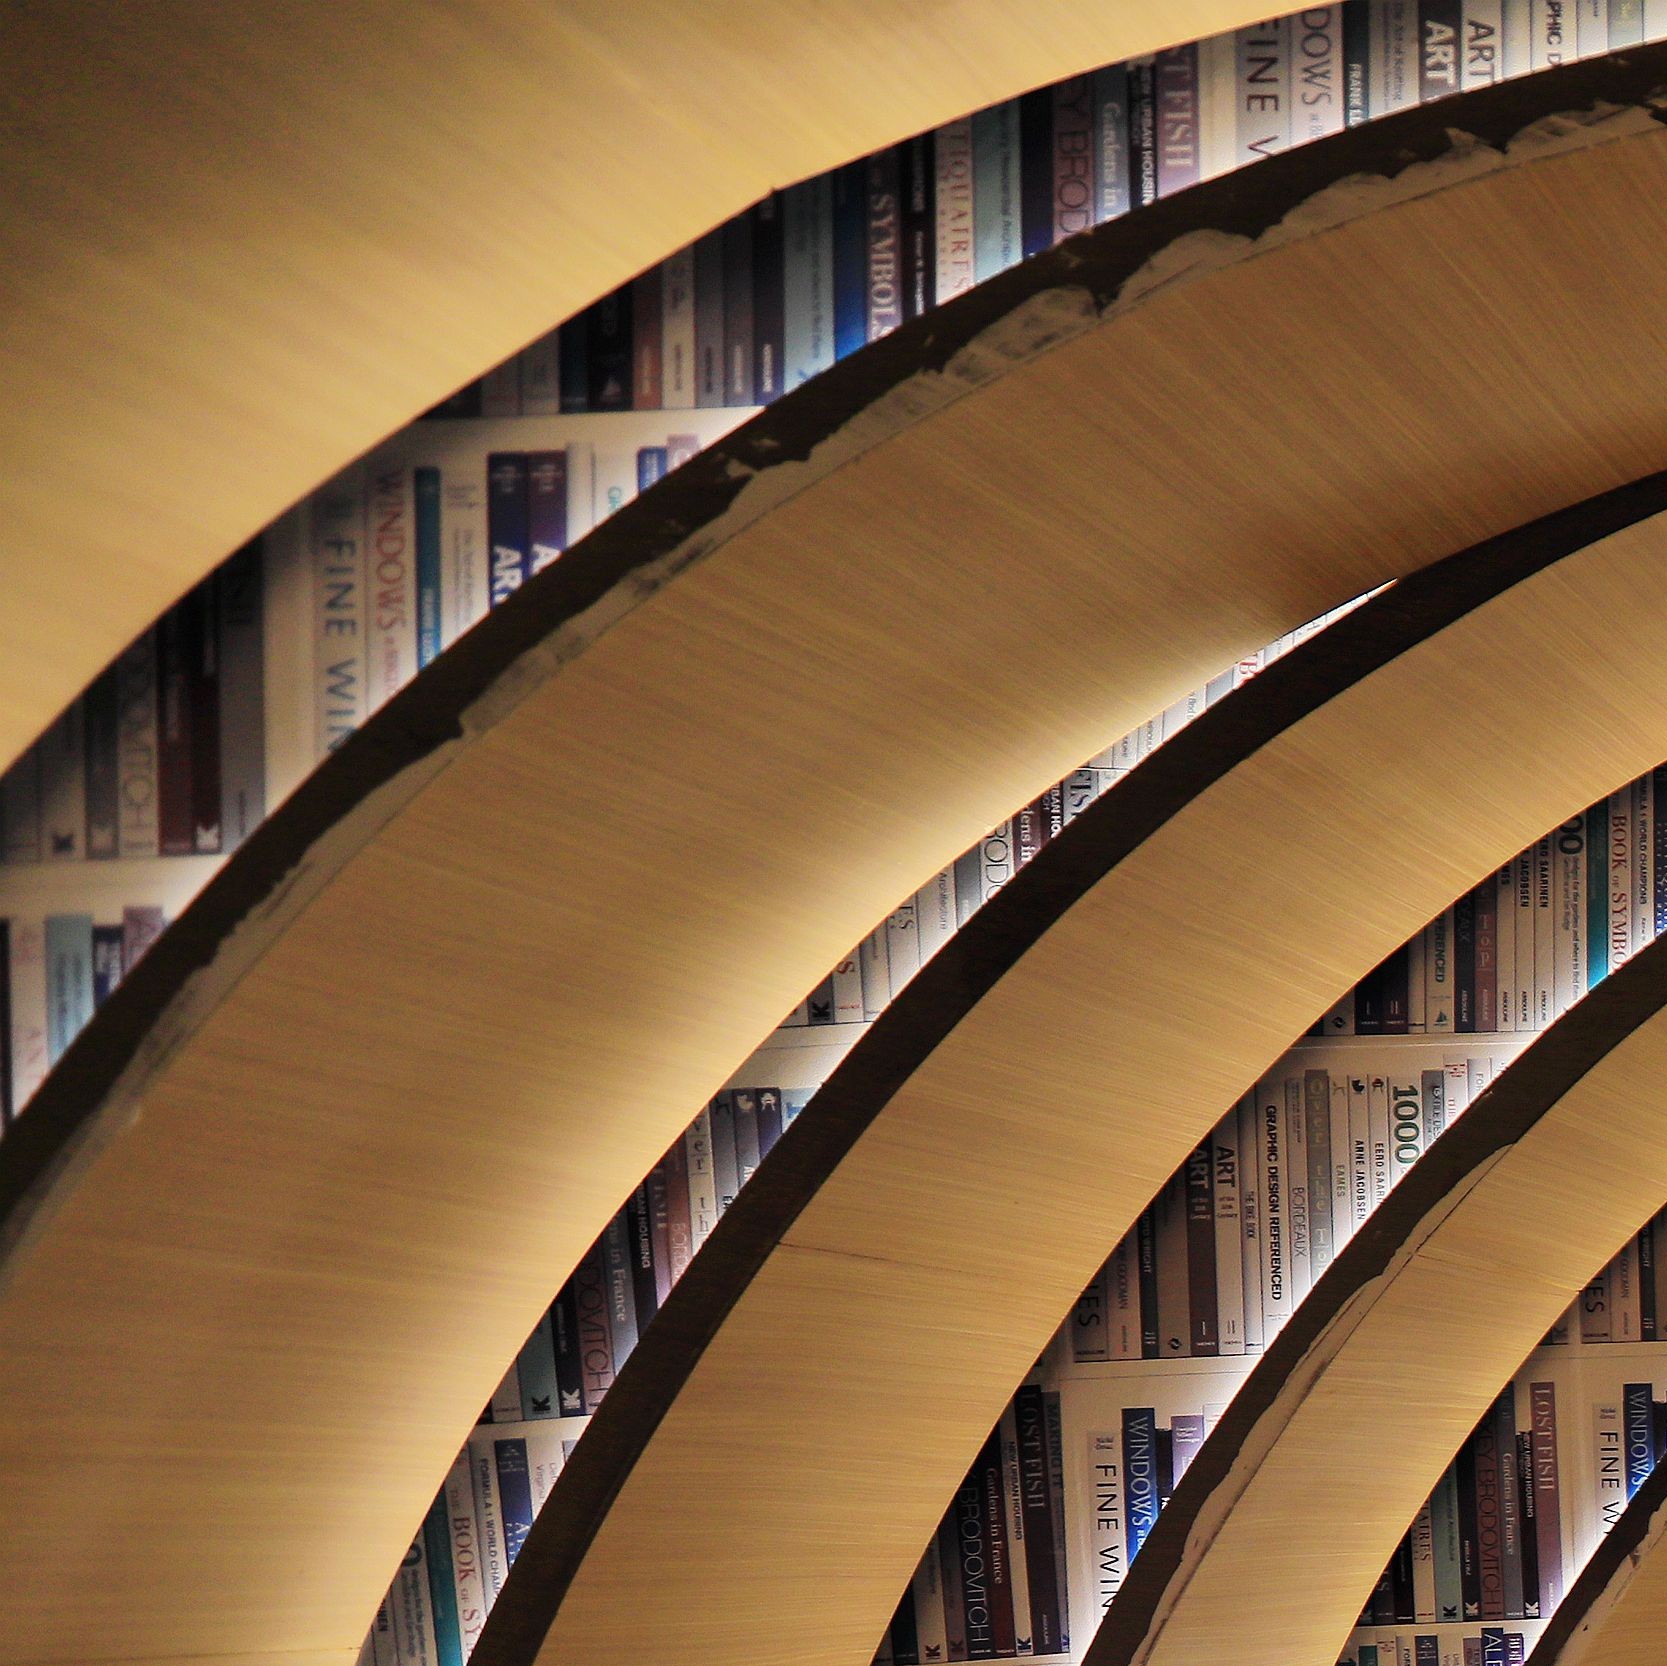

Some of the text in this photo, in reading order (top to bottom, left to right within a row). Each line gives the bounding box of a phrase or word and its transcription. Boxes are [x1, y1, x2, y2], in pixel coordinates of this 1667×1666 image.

[1426, 20, 1455, 86] ART
[1467, 18, 1496, 80] ART
[324, 537, 357, 637] FINE
[1611, 815, 1627, 869] BOOK
[1392, 1085, 1420, 1164] 1000
[1216, 1146, 1235, 1188] ART
[1336, 1164, 1345, 1198] EAMES
[1355, 1140, 1366, 1220] ARNE JACOBSEN
[1265, 1105, 1282, 1300] GRAPHIC DESIGN REFERENCED
[1023, 1392, 1045, 1509] LOST FISH
[1129, 1416, 1152, 1527] WINDOWS
[1534, 1389, 1554, 1490] LOST FISH
[1600, 1431, 1620, 1490] FINE
[1095, 1464, 1119, 1531] FINE
[1503, 1453, 1514, 1500] Gardens
[452, 1516, 476, 1582] BOOK
[986, 1467, 1003, 1585] Gardens France
[1013, 1499, 1022, 1540] HOUSING
